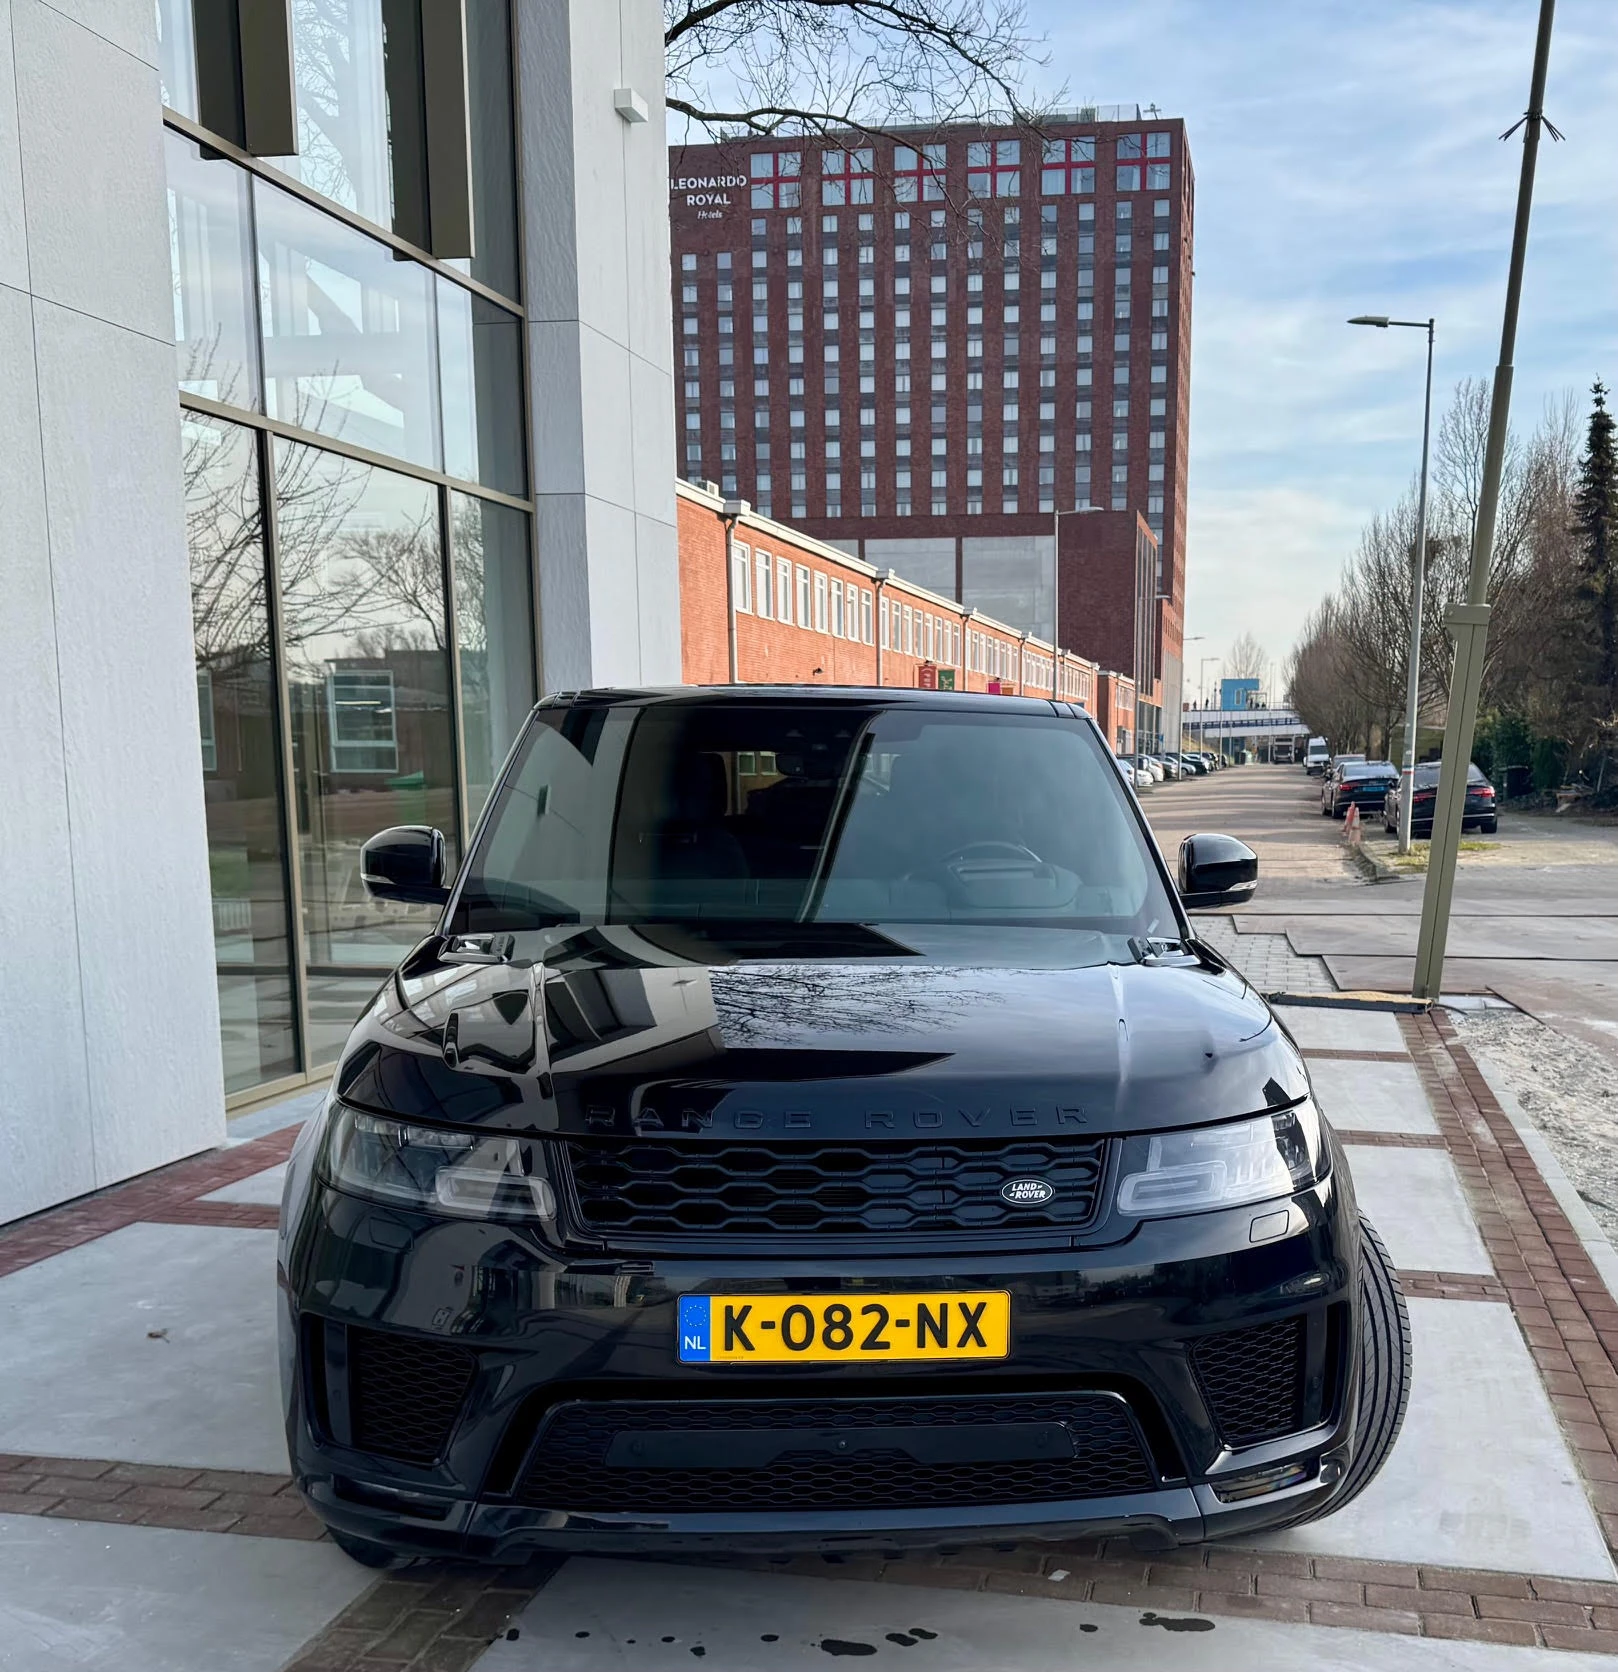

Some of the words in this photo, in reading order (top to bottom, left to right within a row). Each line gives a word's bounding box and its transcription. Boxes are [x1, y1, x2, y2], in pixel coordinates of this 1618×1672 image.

[671, 175, 747, 190] LEONARDO
[687, 193, 731, 206] ROYAL
[585, 1105, 811, 1129] RANGE
[864, 1104, 1089, 1129] ROVER
[1012, 1183, 1037, 1191] LAND
[1014, 1190, 1046, 1199] ROVER
[724, 1302, 987, 1352] K-082-NX
[684, 1335, 706, 1350] NL
